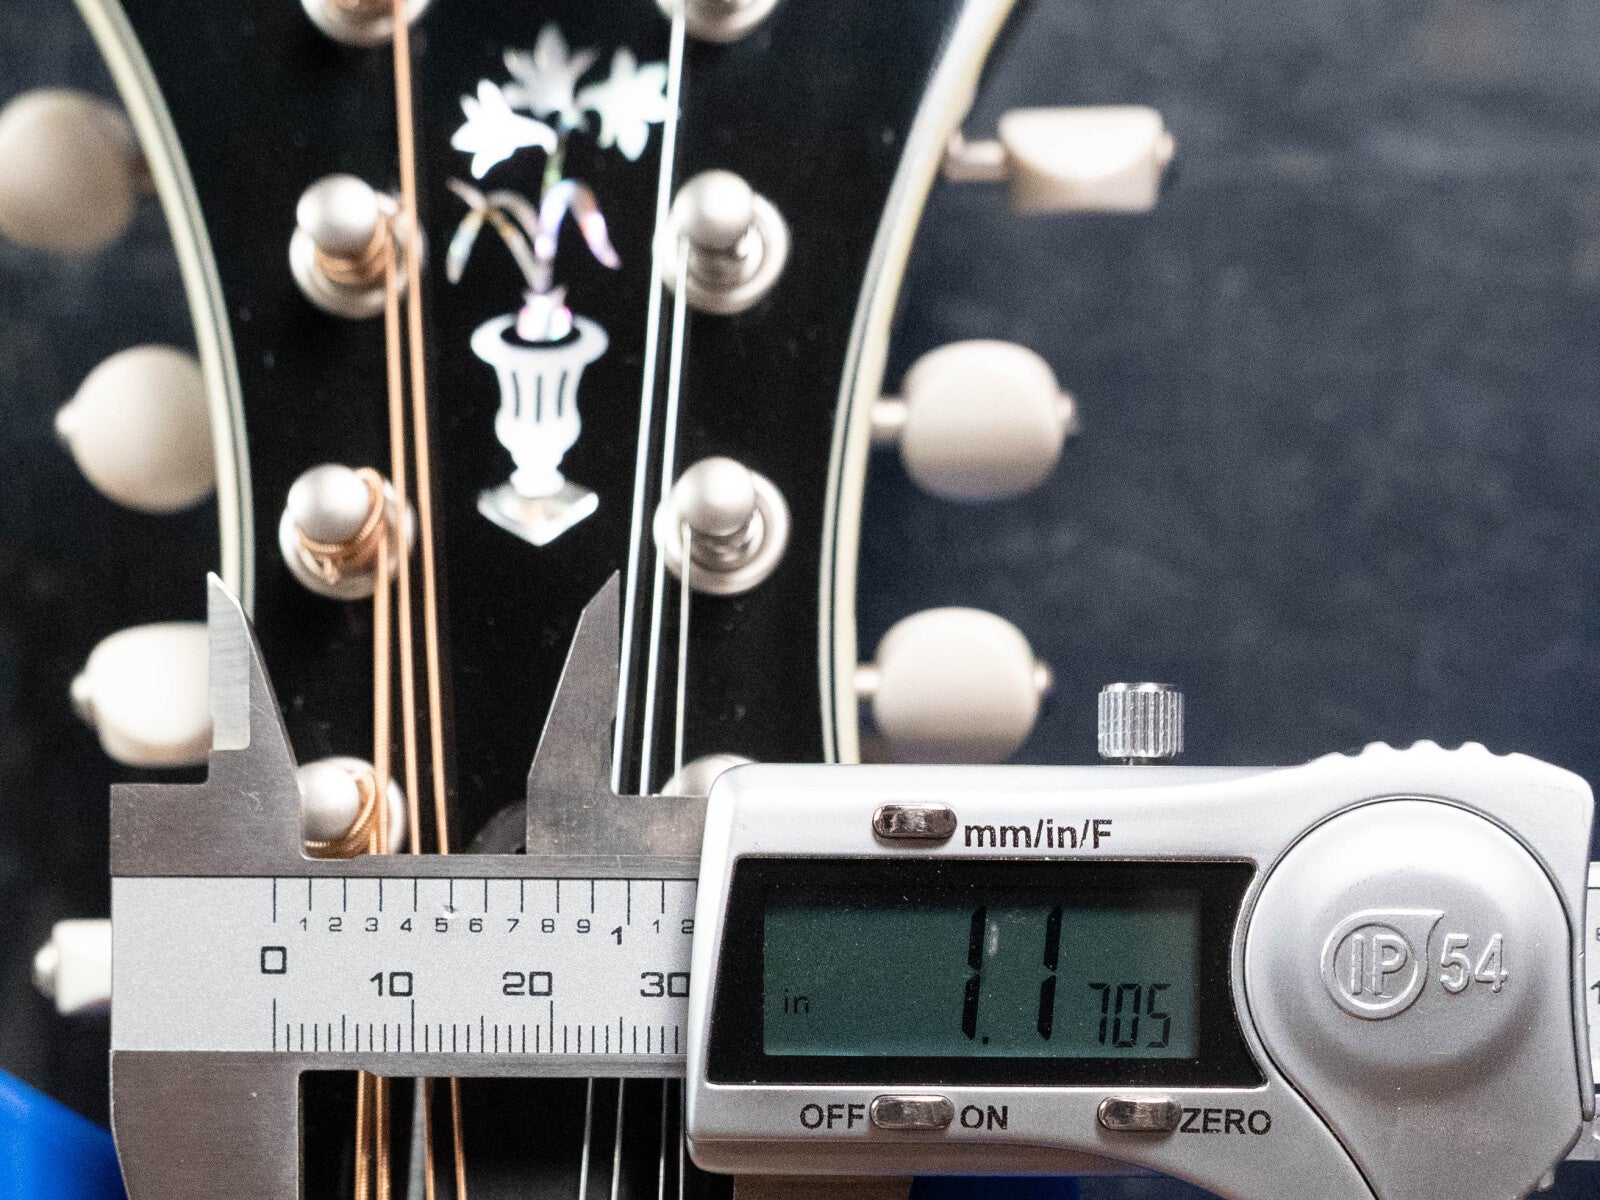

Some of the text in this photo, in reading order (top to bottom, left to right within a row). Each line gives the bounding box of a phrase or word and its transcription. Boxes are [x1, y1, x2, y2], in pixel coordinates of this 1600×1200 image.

[965, 819, 1113, 849] mm/in/F
[299, 917, 695, 945] 1 2 3 4 5 6 7 8 9 1 1 2
[1351, 933, 1508, 999] IP 54
[369, 971, 691, 998] 10 20 30
[783, 991, 811, 1015] in
[799, 1103, 1009, 1131] OFF ON
[1179, 1107, 1273, 1136] ZERO
